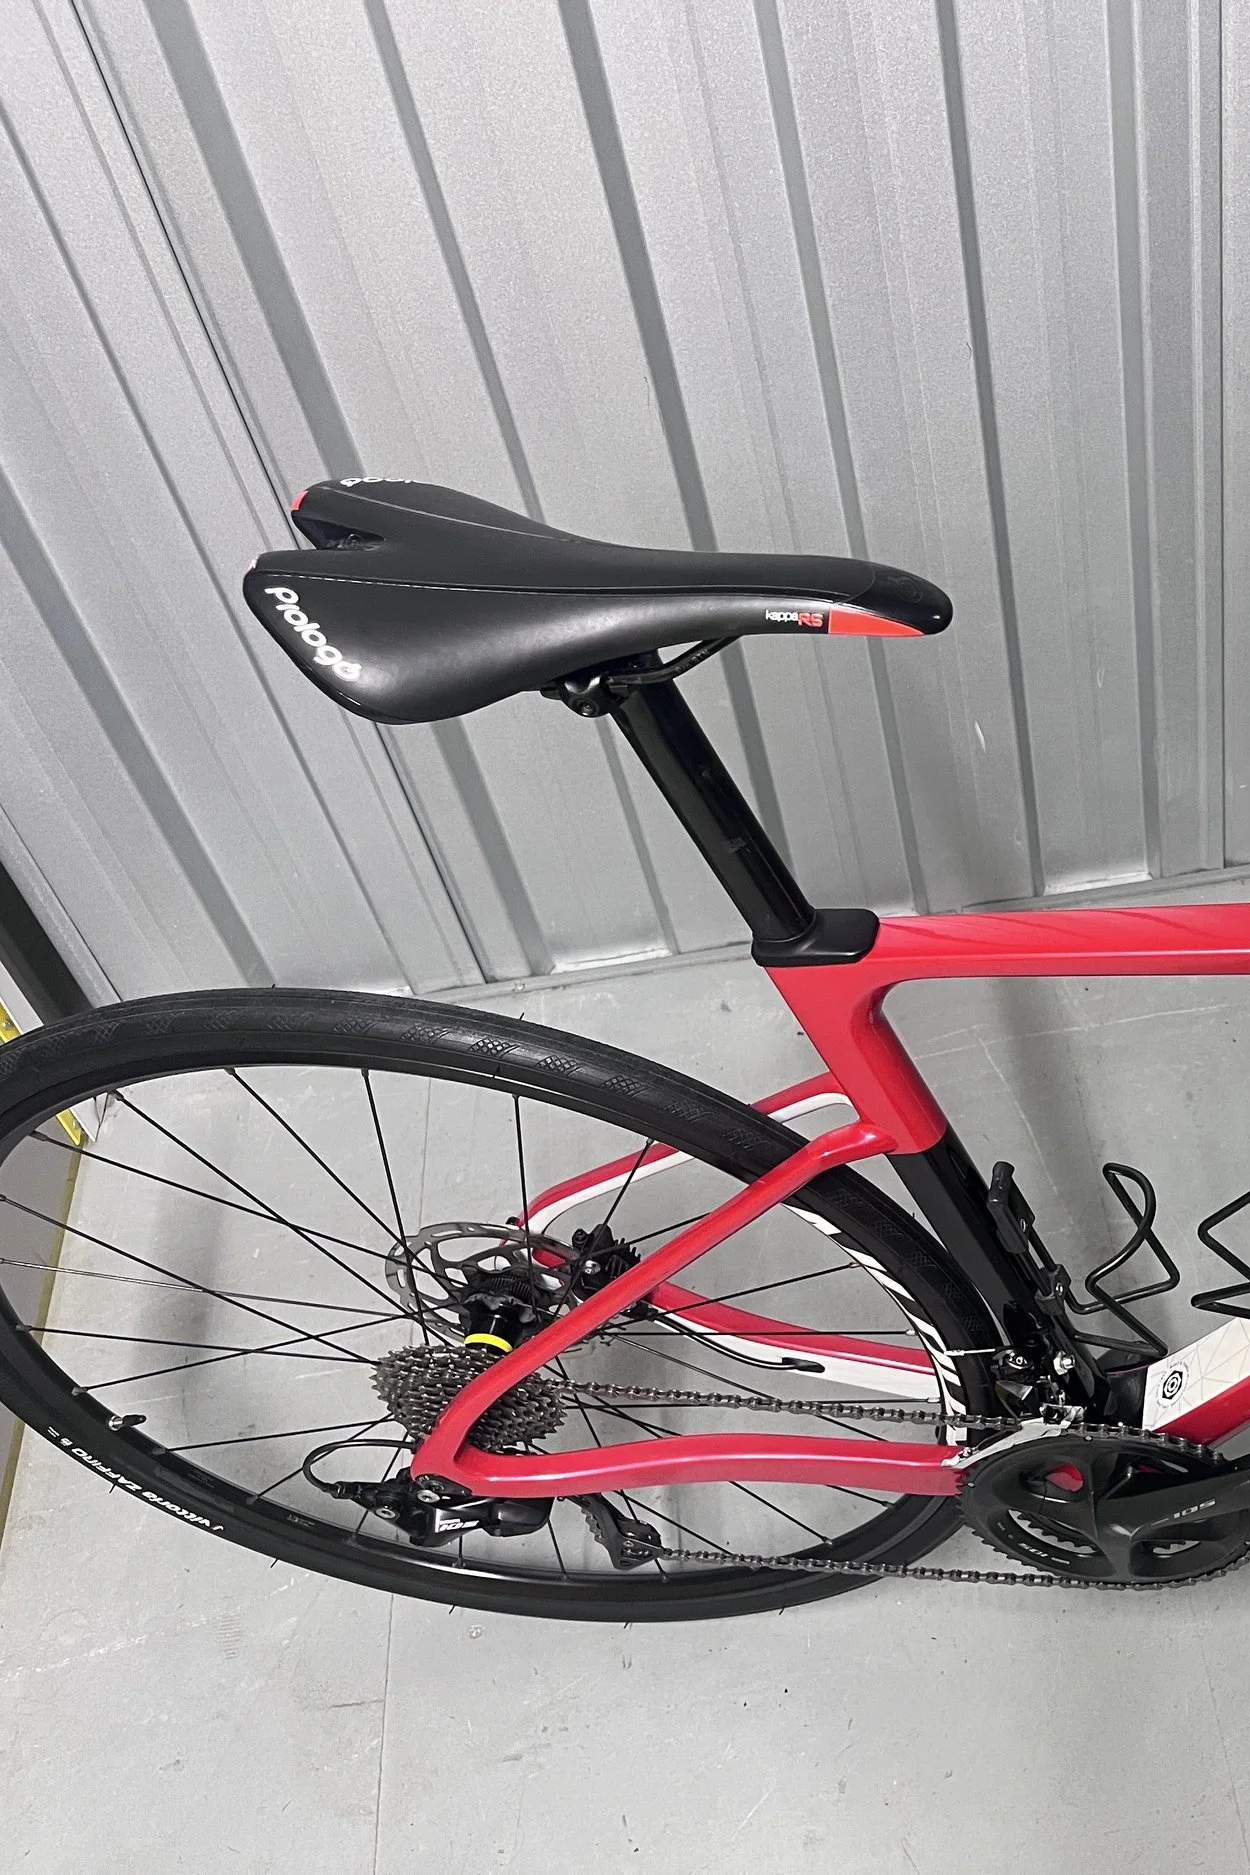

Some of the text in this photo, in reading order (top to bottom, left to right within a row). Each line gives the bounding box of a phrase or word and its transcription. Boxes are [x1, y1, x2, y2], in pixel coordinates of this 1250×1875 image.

[264, 587, 362, 681] Prologo
[71, 1447, 143, 1492] ZAFFIRO
[1174, 1499, 1216, 1518] 105
